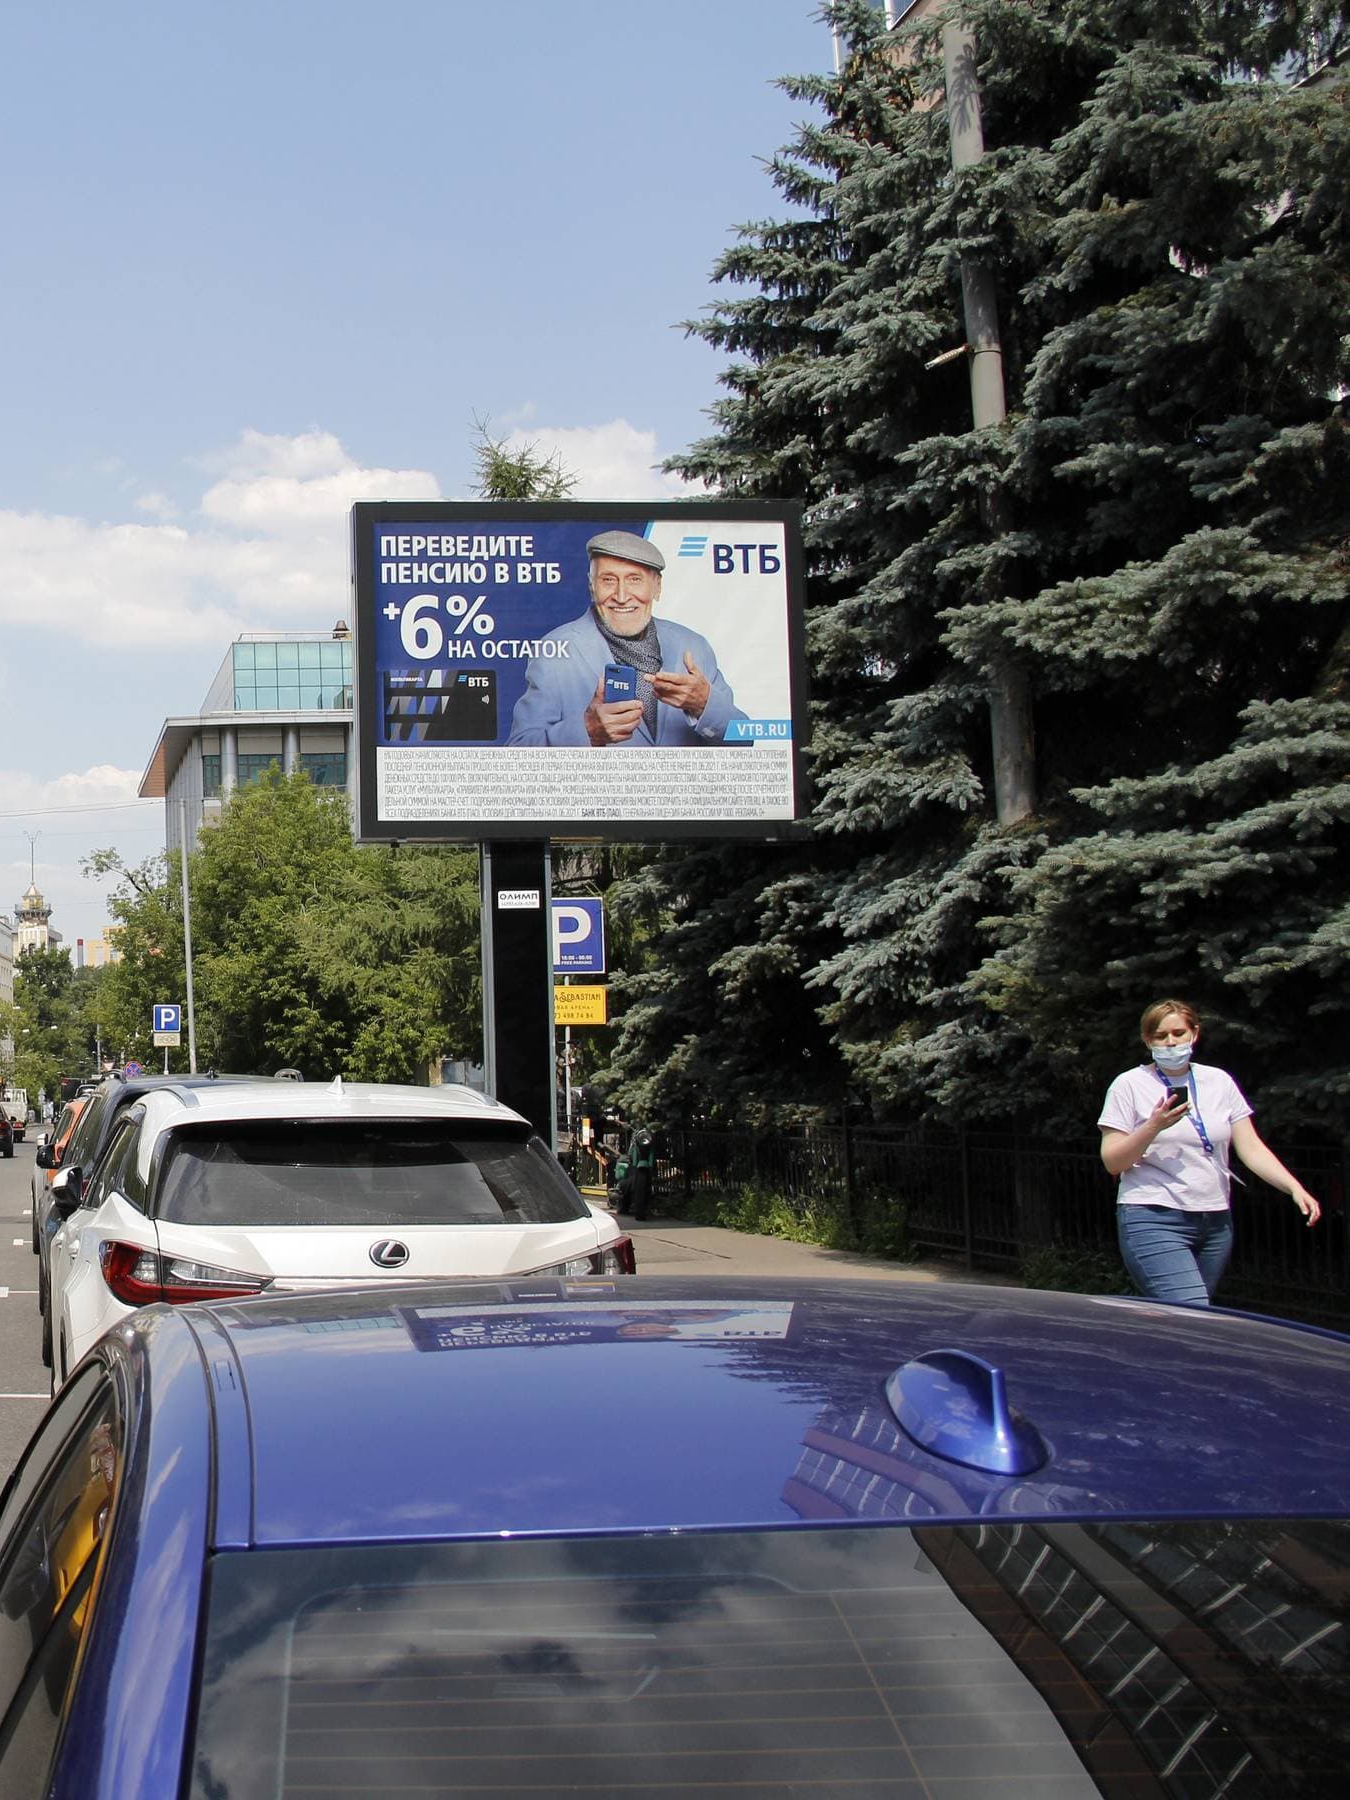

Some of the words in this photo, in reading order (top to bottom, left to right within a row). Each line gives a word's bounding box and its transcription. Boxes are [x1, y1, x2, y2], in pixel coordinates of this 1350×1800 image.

[380, 535, 534, 561] ПЕРЕВЕДИТЕ
[712, 543, 781, 575] ВТБ
[380, 563, 490, 584] ПЕНСИЮ
[495, 563, 510, 584] В
[517, 562, 561, 584] ВТБ
[383, 594, 495, 661] +6%
[448, 640, 476, 659] НА
[481, 640, 570, 659] ОСТАТОК
[468, 676, 489, 687] ВТБ
[613, 681, 629, 691] ВТБ
[737, 723, 787, 737] VTB.RU
[161, 1008, 176, 1029] P
